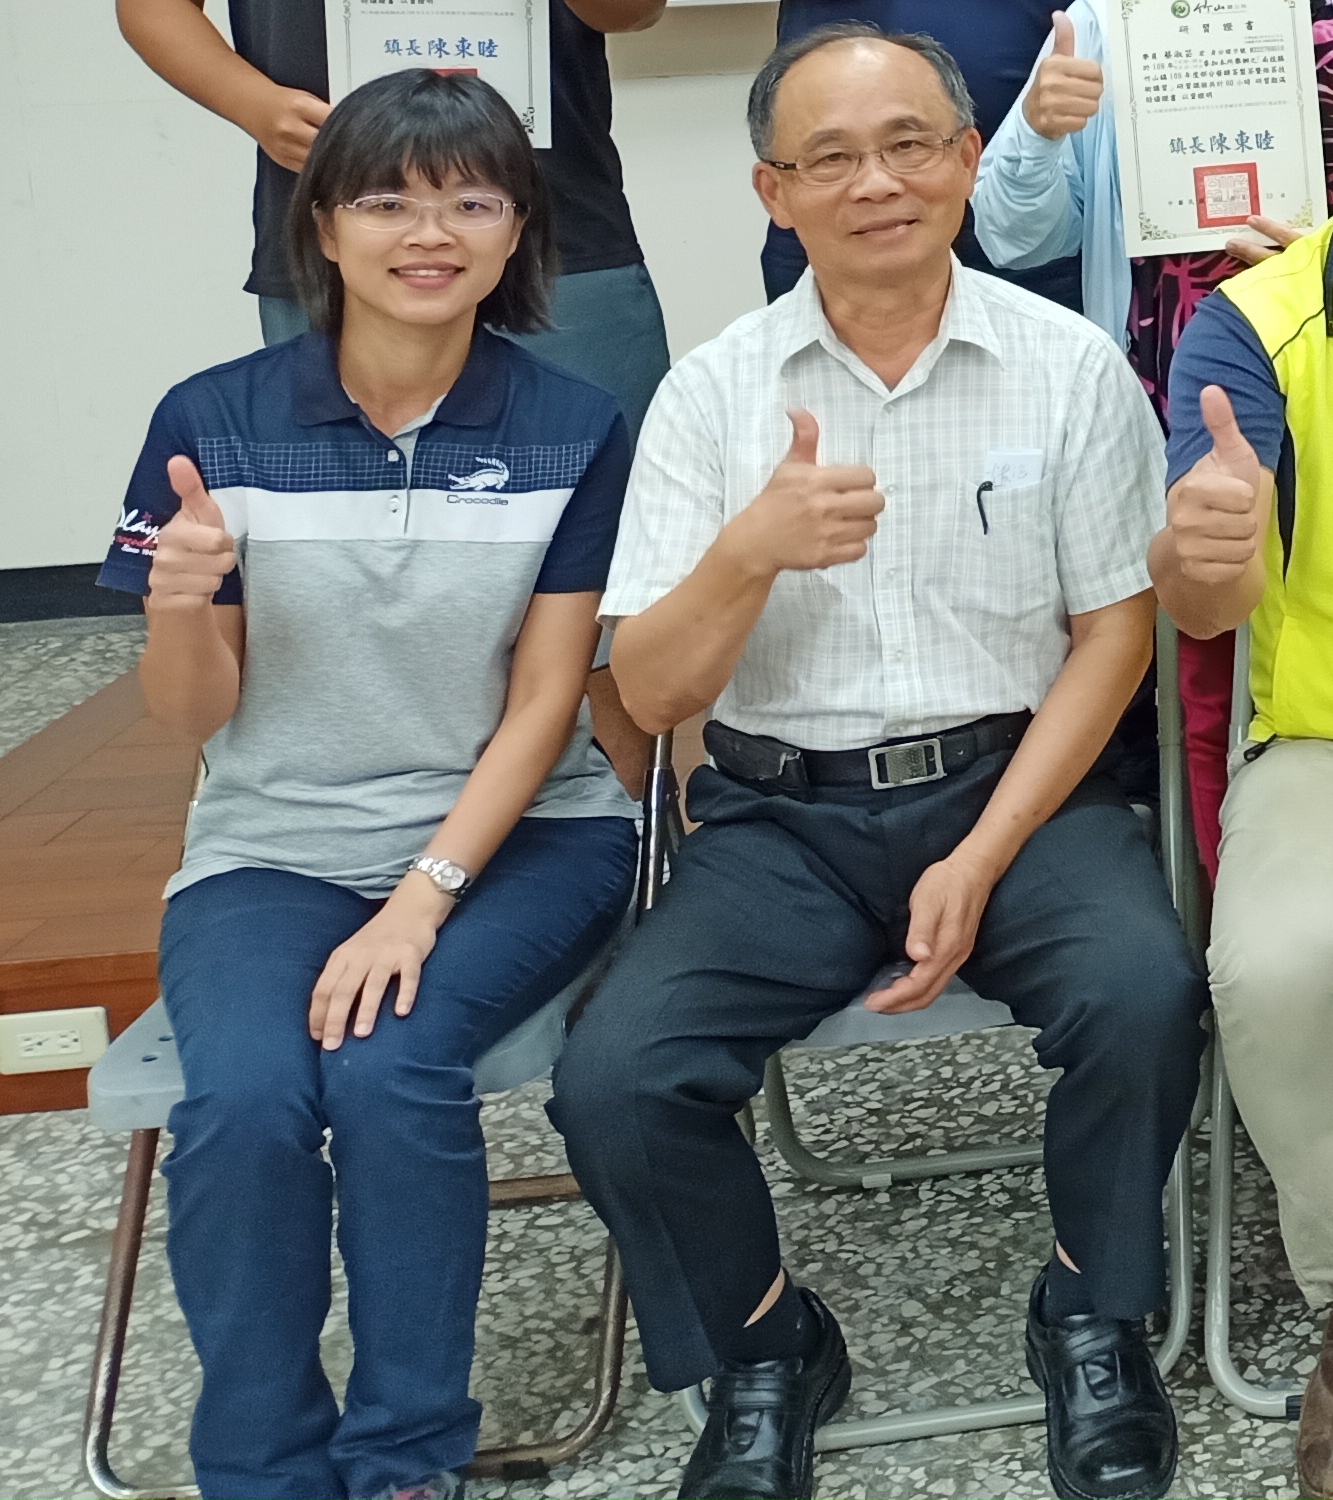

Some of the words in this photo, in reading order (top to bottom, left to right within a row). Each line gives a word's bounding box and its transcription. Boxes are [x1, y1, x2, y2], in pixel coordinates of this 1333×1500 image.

[384, 36, 499, 59] 鎮長陳東睦
[1169, 129, 1275, 155] 鎮長陳東睦
[446, 494, 509, 506] Crocodile
